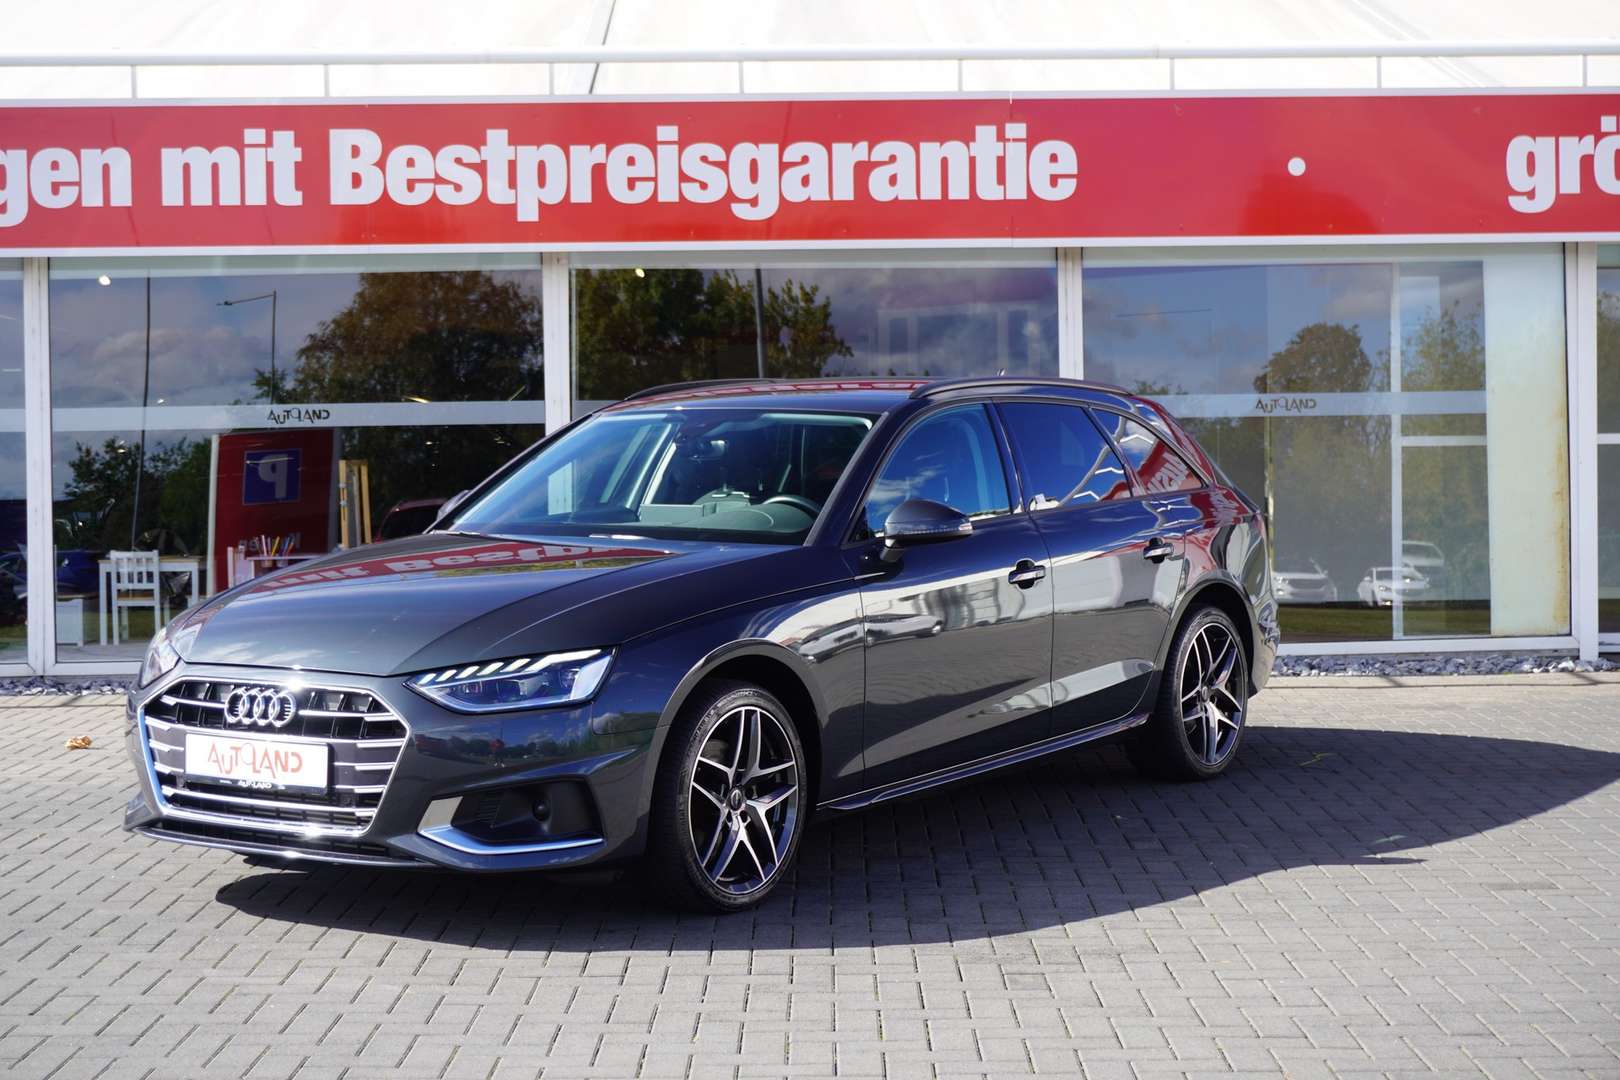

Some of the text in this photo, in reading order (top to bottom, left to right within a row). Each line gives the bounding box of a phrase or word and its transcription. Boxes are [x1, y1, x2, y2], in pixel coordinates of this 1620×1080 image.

[160, 128, 303, 207] mit
[328, 122, 1079, 222] Bestpreisgarantie
[267, 407, 330, 424] AUTOLAND
[207, 741, 304, 779] AUTOLAND
